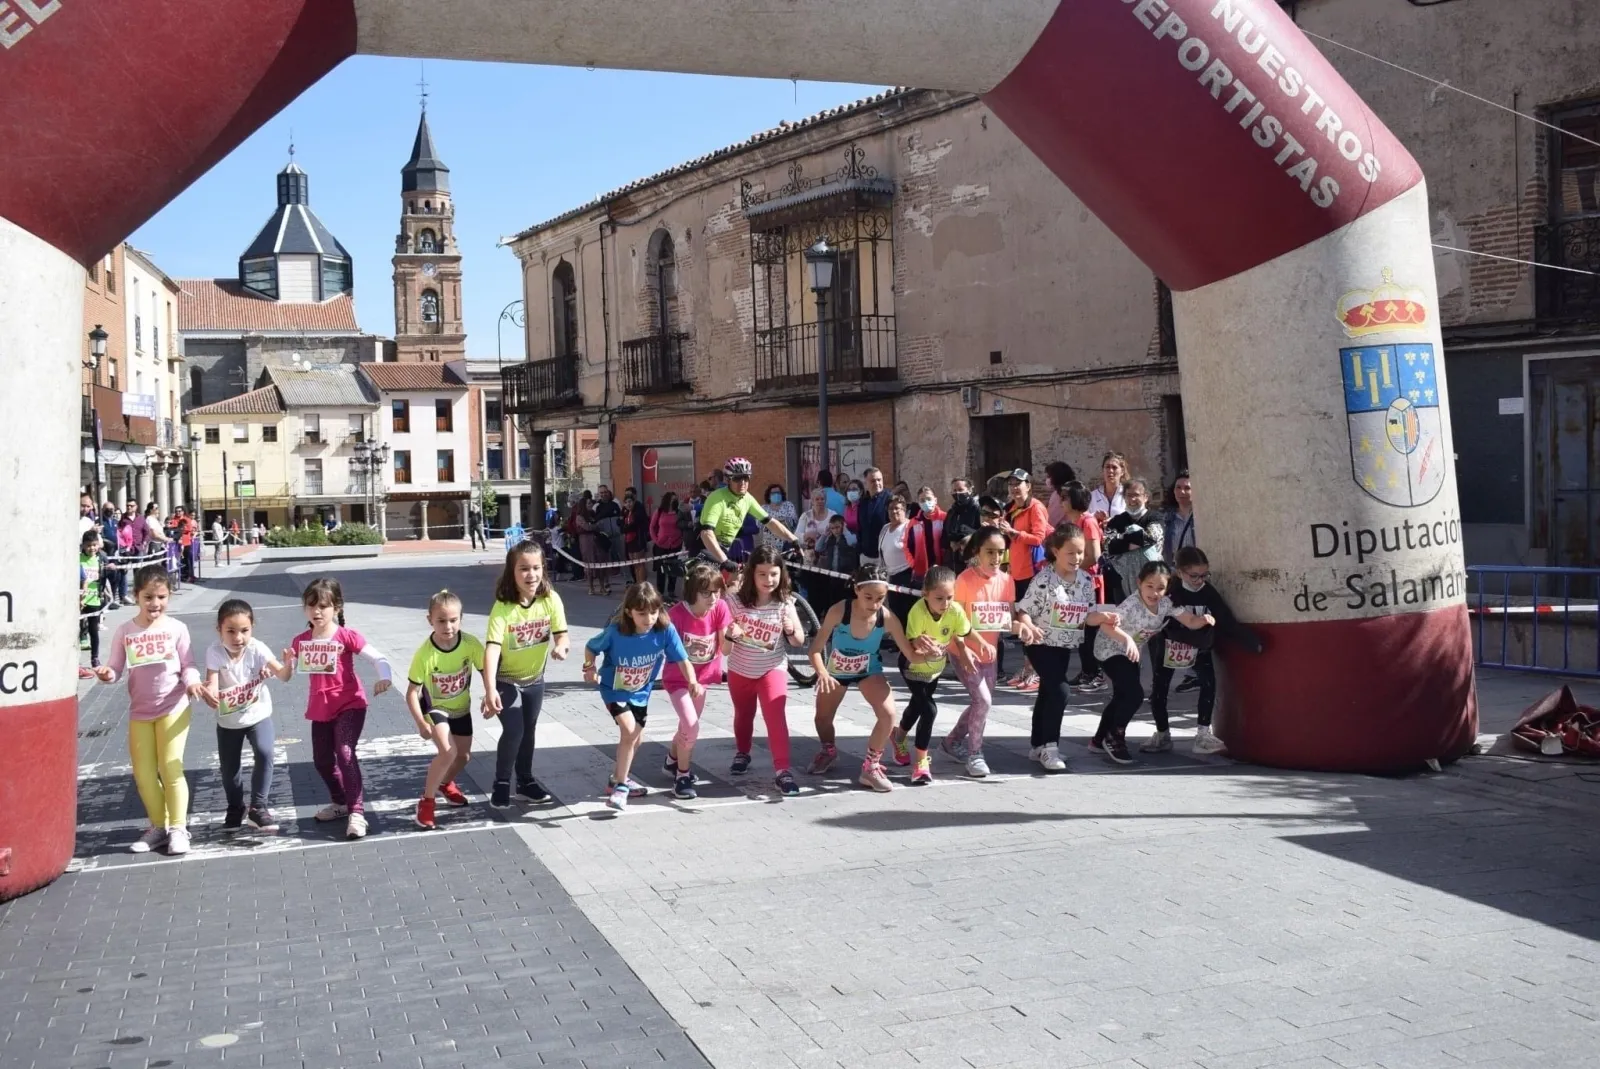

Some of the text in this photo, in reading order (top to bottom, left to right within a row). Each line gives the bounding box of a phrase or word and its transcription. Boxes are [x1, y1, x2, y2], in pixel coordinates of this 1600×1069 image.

[1211, 0, 1381, 183] NUESTROS
[1120, 0, 1340, 208] EPORTISTAS
[1293, 584, 1328, 612] de
[971, 603, 1010, 612] bedunia
[1054, 601, 1088, 612] bedunia
[741, 614, 781, 633] bedunia
[979, 612, 1003, 624] 287
[1058, 611, 1080, 624] 271
[508, 618, 552, 633] bedunia
[516, 627, 542, 643] 276
[744, 626, 771, 643] 280
[135, 641, 166, 658] 285
[300, 642, 337, 652] bedunia
[304, 652, 328, 666] 340
[618, 656, 630, 667] LA
[832, 650, 869, 663] bedunia
[1168, 650, 1191, 662] 264
[835, 661, 861, 671] 269
[228, 690, 253, 709] 286
